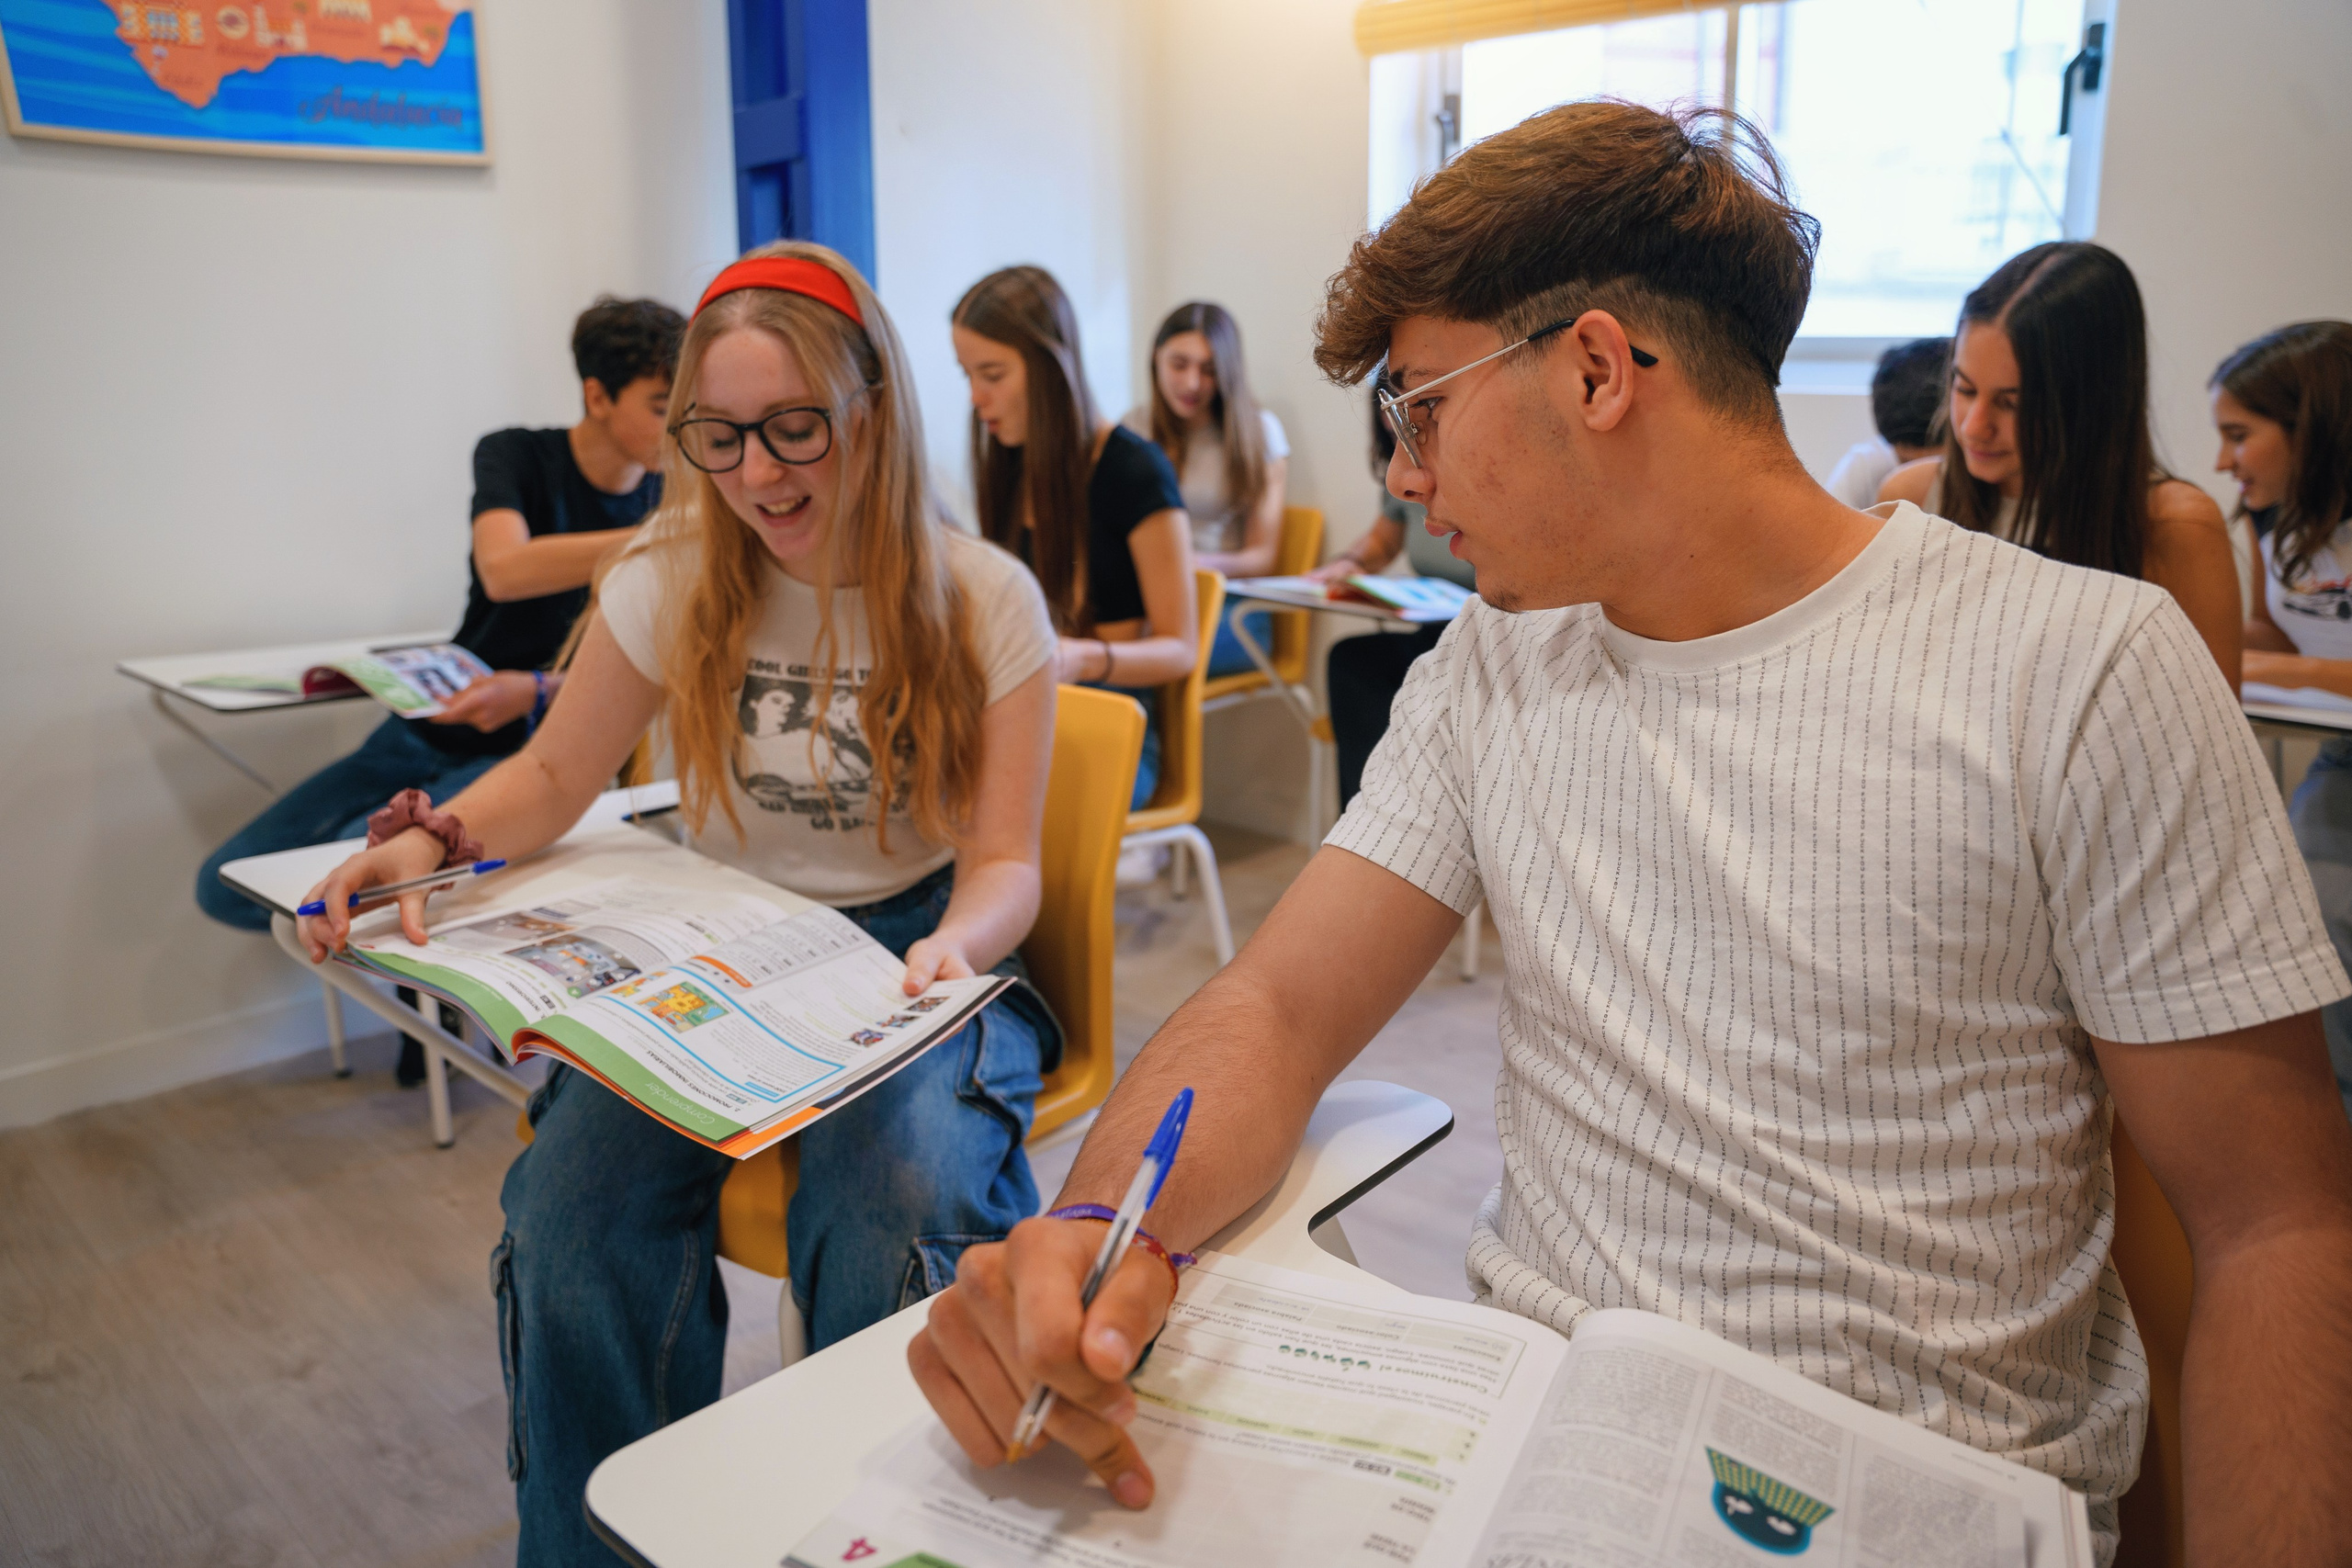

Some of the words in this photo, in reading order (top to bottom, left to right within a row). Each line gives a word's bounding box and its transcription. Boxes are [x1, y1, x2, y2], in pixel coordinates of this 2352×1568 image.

[646, 1048, 690, 1084] INMOBILIARIAS
[668, 1053, 693, 1069] publicado
[686, 1080, 733, 1110] PROMOCIONES
[642, 1079, 716, 1127] Comprender
[1232, 1301, 1270, 1314] asociada
[1183, 1310, 1231, 1325] actividades
[1270, 1310, 1303, 1322] Palabra
[1257, 1328, 1283, 1337] salido
[1334, 1325, 1374, 1335] asociado
[1374, 1331, 1400, 1341] Color
[1283, 1334, 1300, 1343] han
[1452, 1345, 1502, 1361] Emociones
[1379, 1364, 1393, 1372] el
[1395, 1366, 1488, 1394] Construimos
[842, 1538, 876, 1561] 4
